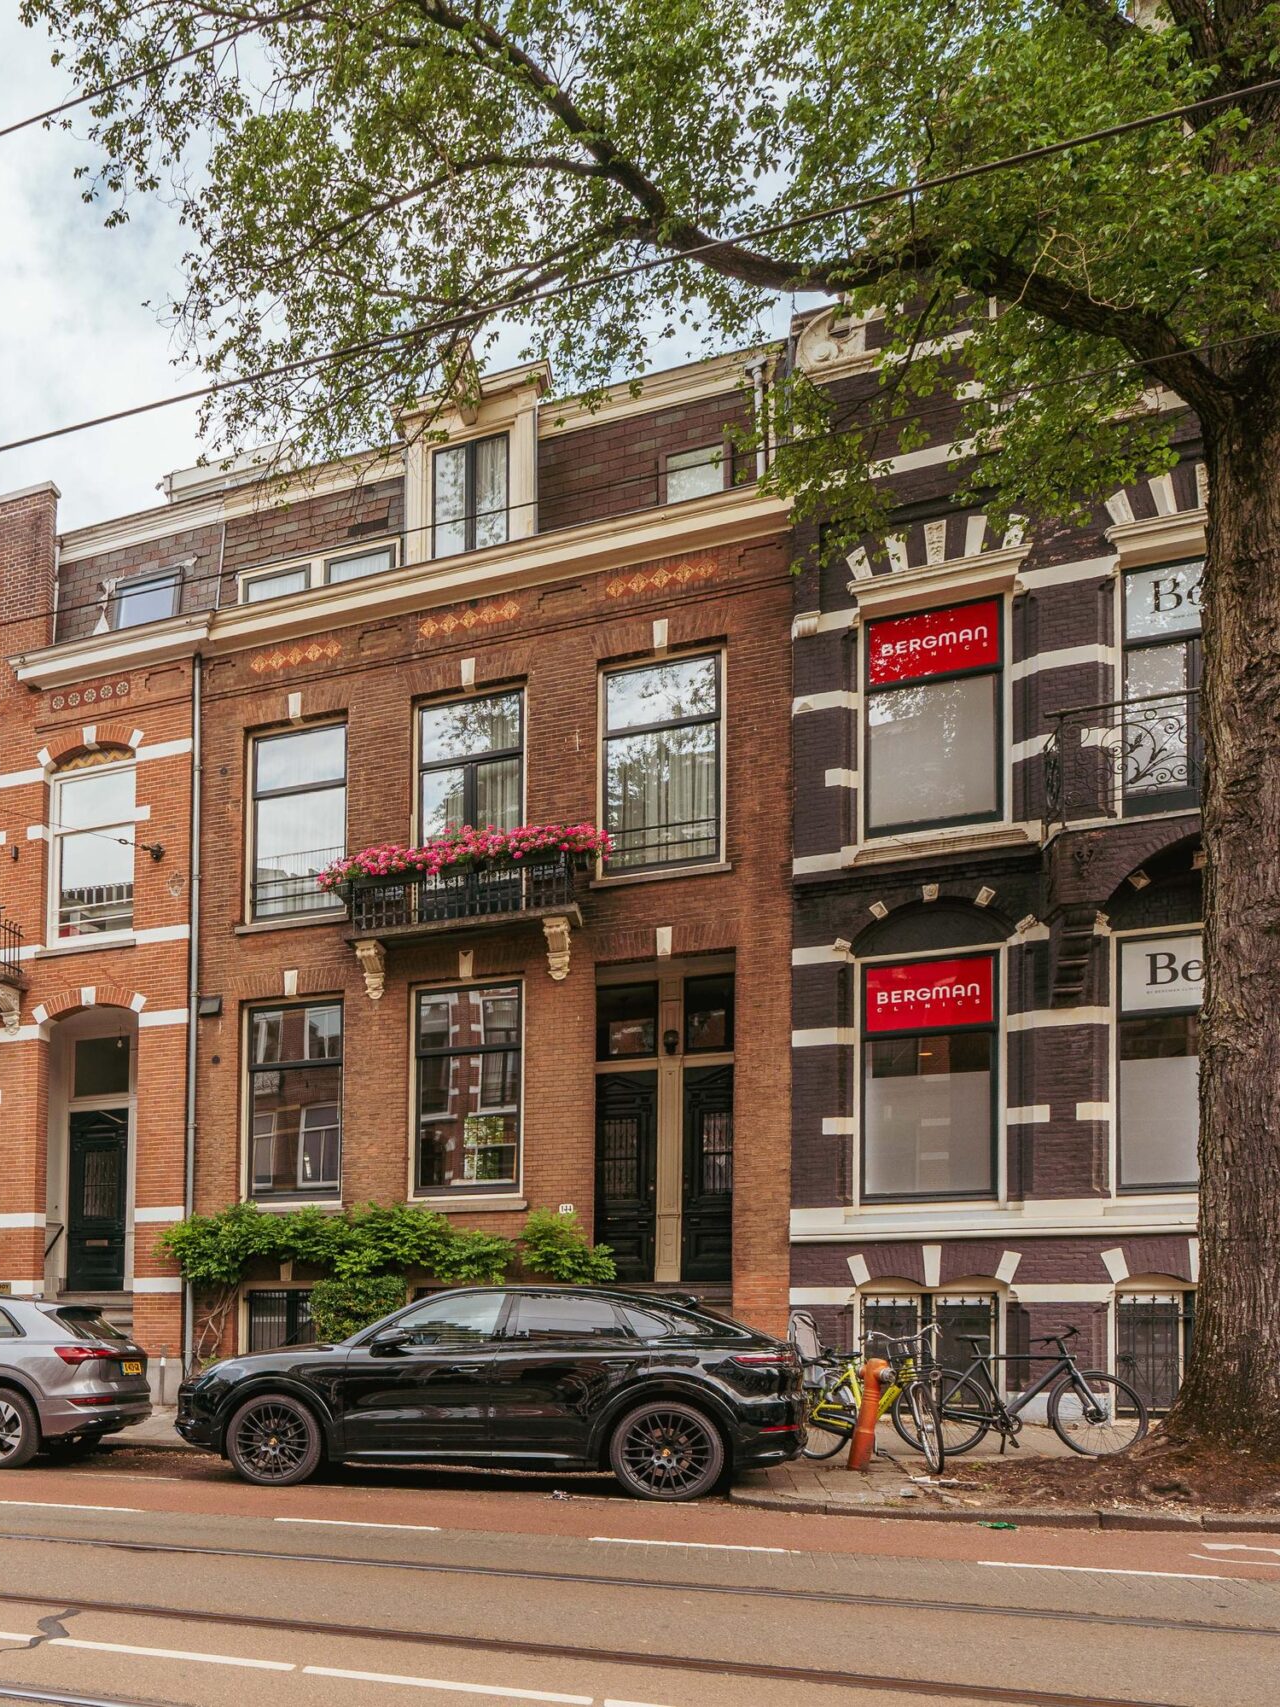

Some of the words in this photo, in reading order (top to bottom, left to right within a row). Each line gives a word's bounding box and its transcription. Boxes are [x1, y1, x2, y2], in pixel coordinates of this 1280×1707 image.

[881, 626, 988, 657] BERGMAN
[877, 983, 980, 1005] BERGMAN
[877, 998, 980, 1014] CLINICS
